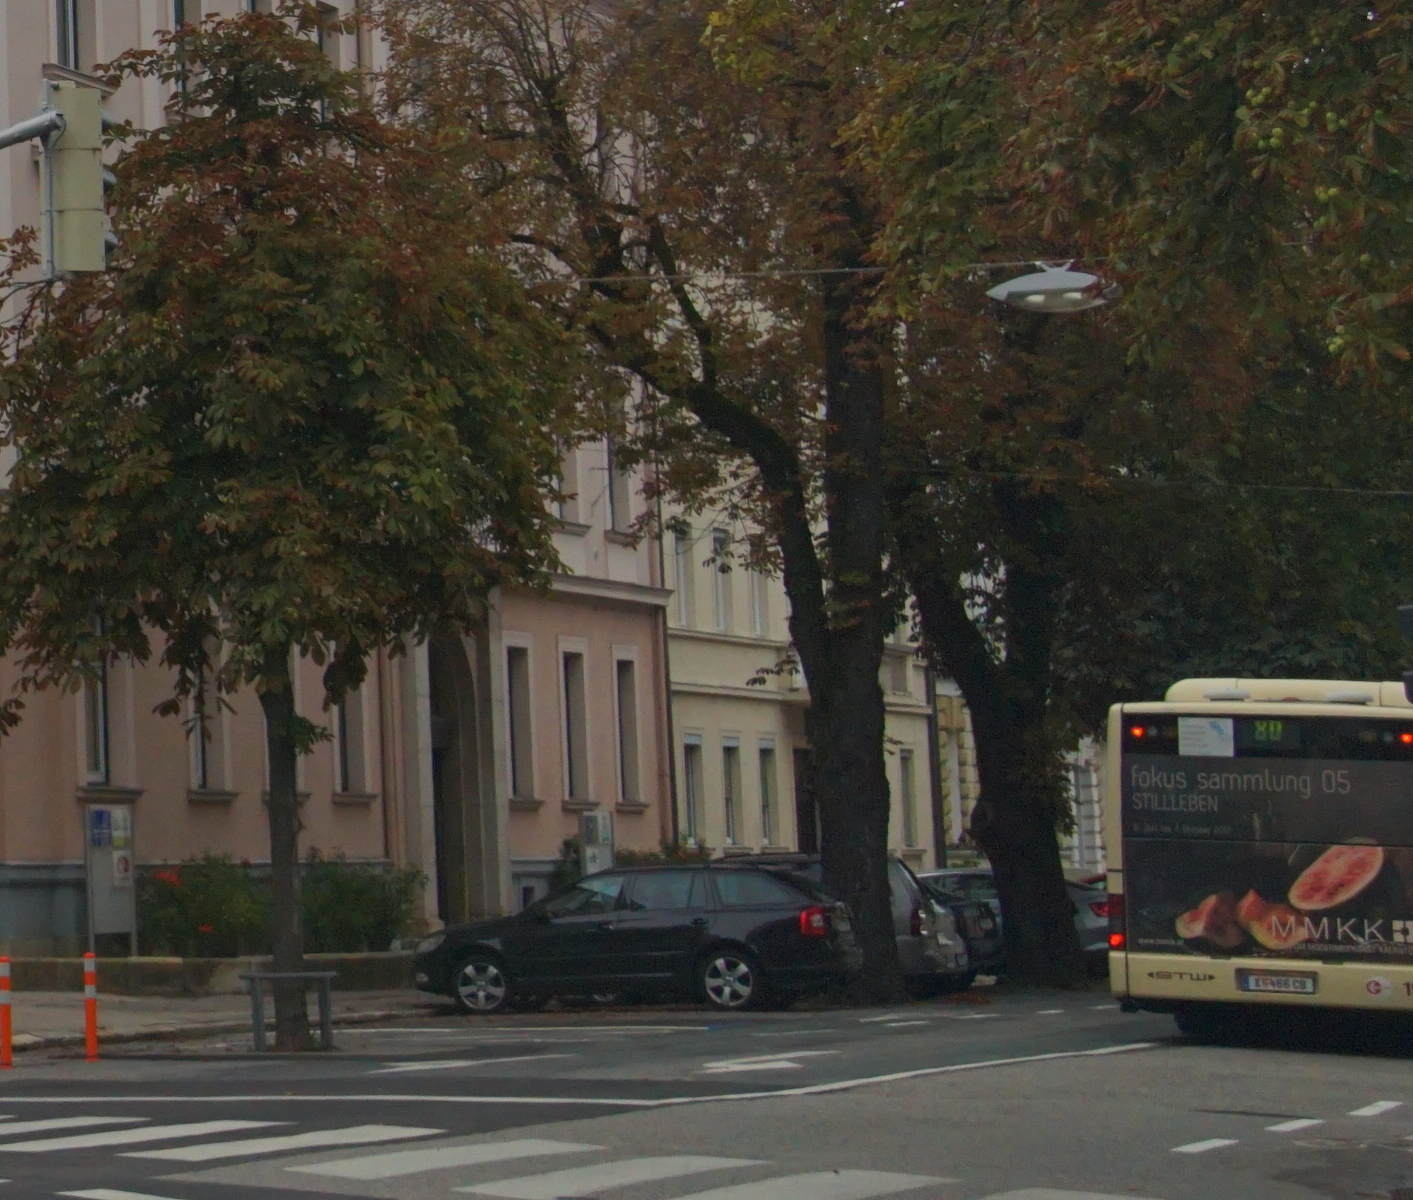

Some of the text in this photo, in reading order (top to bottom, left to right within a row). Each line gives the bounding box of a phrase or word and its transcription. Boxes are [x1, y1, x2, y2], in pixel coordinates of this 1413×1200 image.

[1131, 764, 1351, 800] fokus sammlung 05
[1131, 793, 1219, 813] STILLLEBEN
[1272, 915, 1386, 942] MMKK
[1402, 981, 1413, 996] 1
